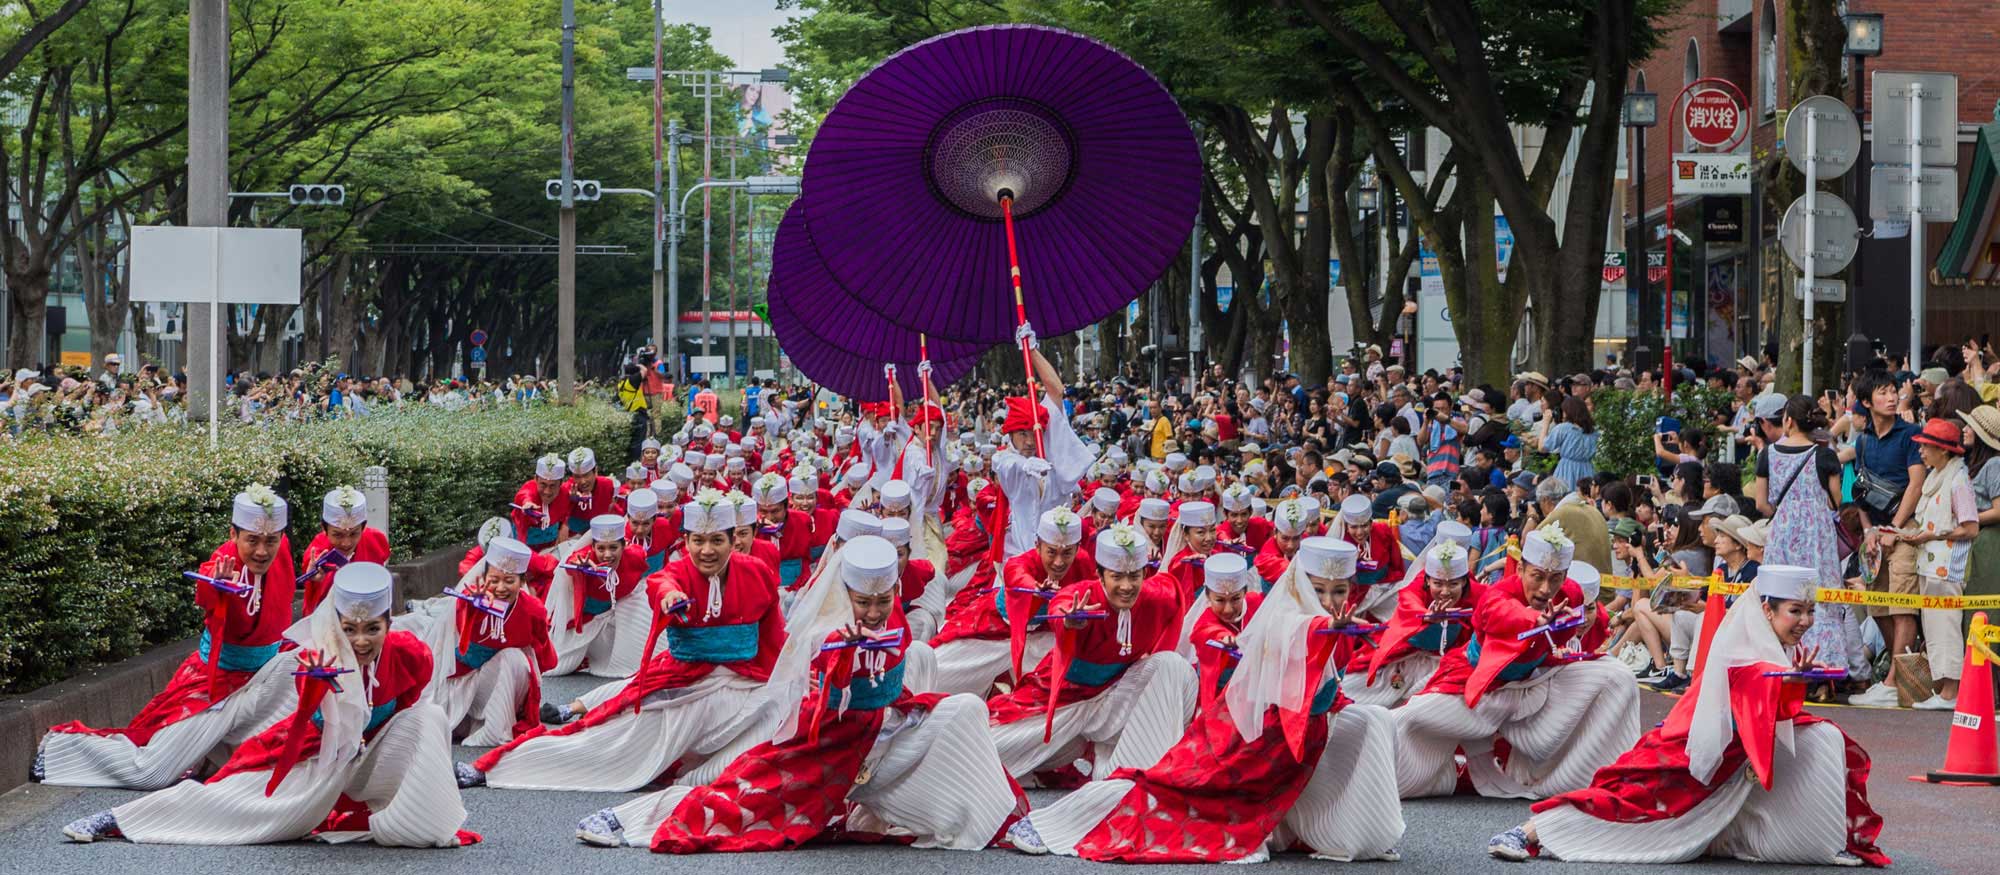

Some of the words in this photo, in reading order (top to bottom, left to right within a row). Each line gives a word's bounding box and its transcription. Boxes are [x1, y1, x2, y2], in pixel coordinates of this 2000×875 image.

[1690, 106, 1735, 129] 消火栓
[1700, 165, 1748, 180] 渋谷のラジオ
[1603, 253, 1622, 266] AG
[1824, 590, 1863, 604] 立入禁止
[1867, 594, 1917, 605] 入らないでください
[1922, 597, 1964, 609] 立入禁止
